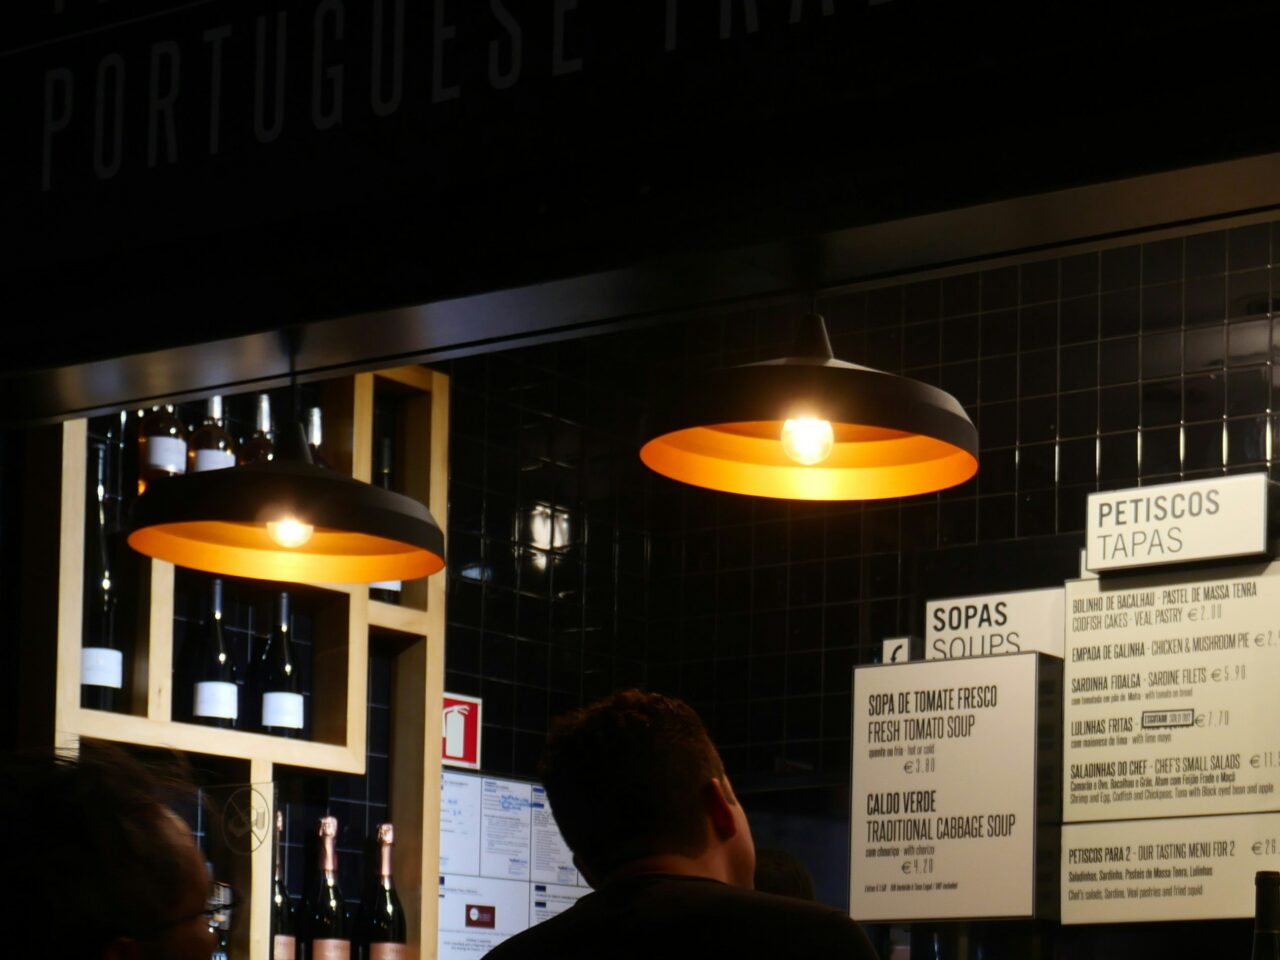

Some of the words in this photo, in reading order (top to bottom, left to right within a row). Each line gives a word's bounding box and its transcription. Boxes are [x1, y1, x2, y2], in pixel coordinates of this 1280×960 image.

[39, 0, 584, 192] PORTUGUESE
[1099, 489, 1220, 528] PETISCOS
[1097, 527, 1183, 560] TAPAS
[1073, 596, 1103, 614] BOLINHO
[1106, 595, 1114, 611] DE
[1117, 592, 1155, 610] BACALHAU
[1163, 588, 1188, 606] PASTEL
[1192, 587, 1200, 603] DE
[1203, 584, 1229, 602] MASSA
[1233, 582, 1257, 599] TENRA
[933, 602, 1008, 632] SOPAS
[932, 632, 1020, 660] SOUPS
[1072, 676, 1108, 693] SARDINHA
[1111, 673, 1140, 690] FIDALGA
[1148, 670, 1179, 687] SARDINE
[1183, 667, 1206, 685] FILETS
[869, 693, 895, 717] SOPA
[899, 691, 910, 714] DE
[914, 688, 954, 713] TOMATE
[958, 685, 997, 710] FRESCO
[869, 720, 900, 744] FRESH
[904, 717, 944, 741] TOMATO
[948, 715, 975, 739] SOUP
[1071, 719, 1105, 736] LULINHAS
[1109, 717, 1133, 733] FRITAS
[1071, 762, 1115, 779] SALADINHAS
[1118, 761, 1127, 776] DO
[1129, 760, 1147, 775] CHEF
[1155, 758, 1180, 774] CHEF'S
[1183, 756, 1208, 772] SMALL
[1211, 754, 1240, 770] SALADS
[867, 792, 900, 816] CALDO
[903, 790, 936, 814] VERDE
[867, 818, 933, 842] TRADITIONAL
[937, 815, 984, 840] CABBAGE
[987, 814, 1015, 838] SOUP
[1069, 848, 1102, 864] PETISCOS
[1105, 847, 1123, 862] PARA
[1126, 847, 1130, 861] 2
[1138, 845, 1153, 861] OUR
[1157, 844, 1186, 860] TASTING
[1189, 843, 1210, 858] MENU
[1213, 842, 1227, 857] FOR
[1230, 841, 1234, 857] 2
